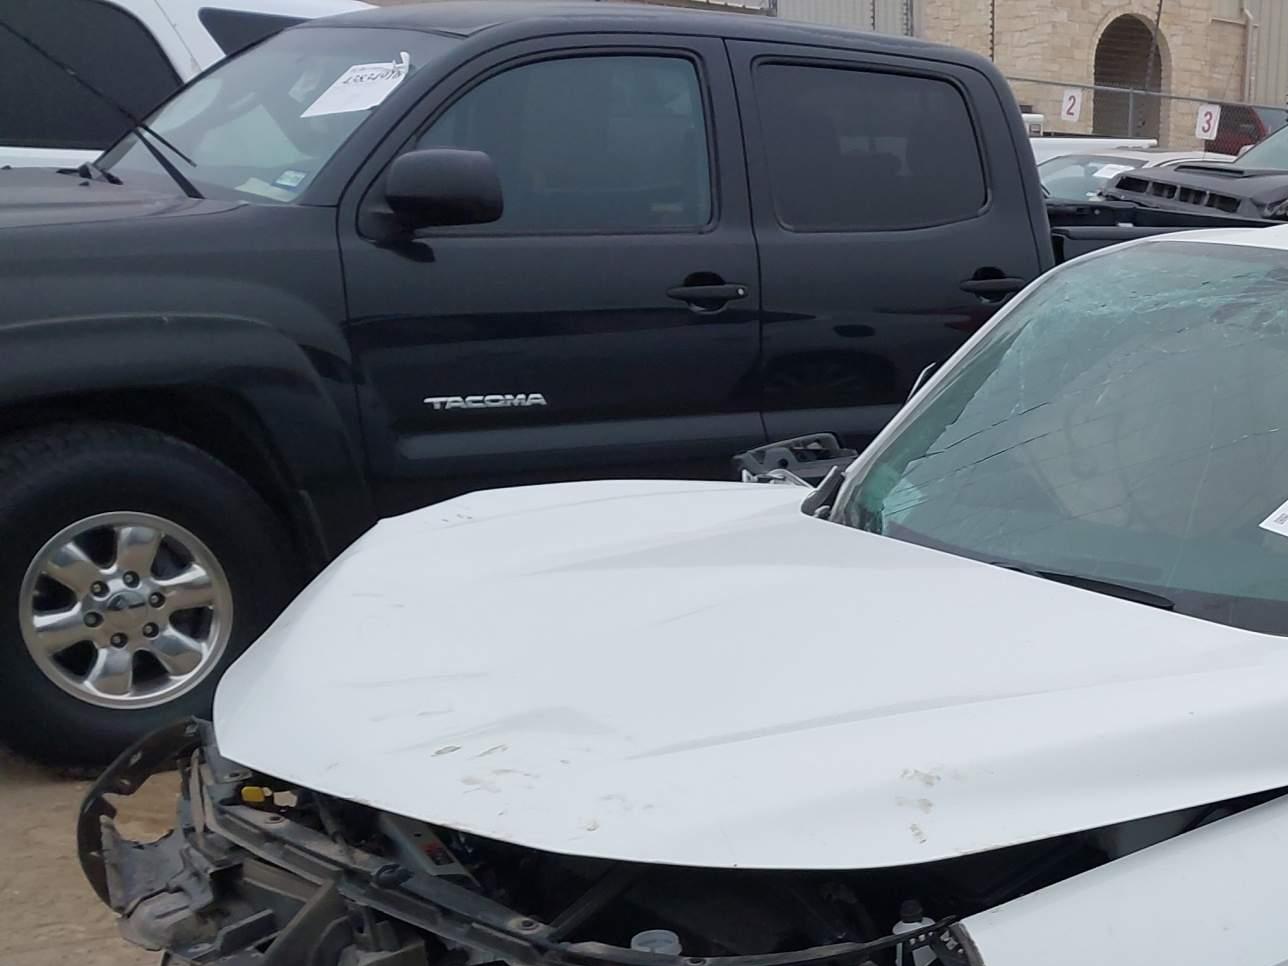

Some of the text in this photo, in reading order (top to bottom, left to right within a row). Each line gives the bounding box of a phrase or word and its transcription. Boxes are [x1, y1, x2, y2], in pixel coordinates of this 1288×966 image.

[1066, 95, 1077, 116] 2
[1201, 111, 1213, 134] 3
[424, 394, 547, 409] TACOMA
